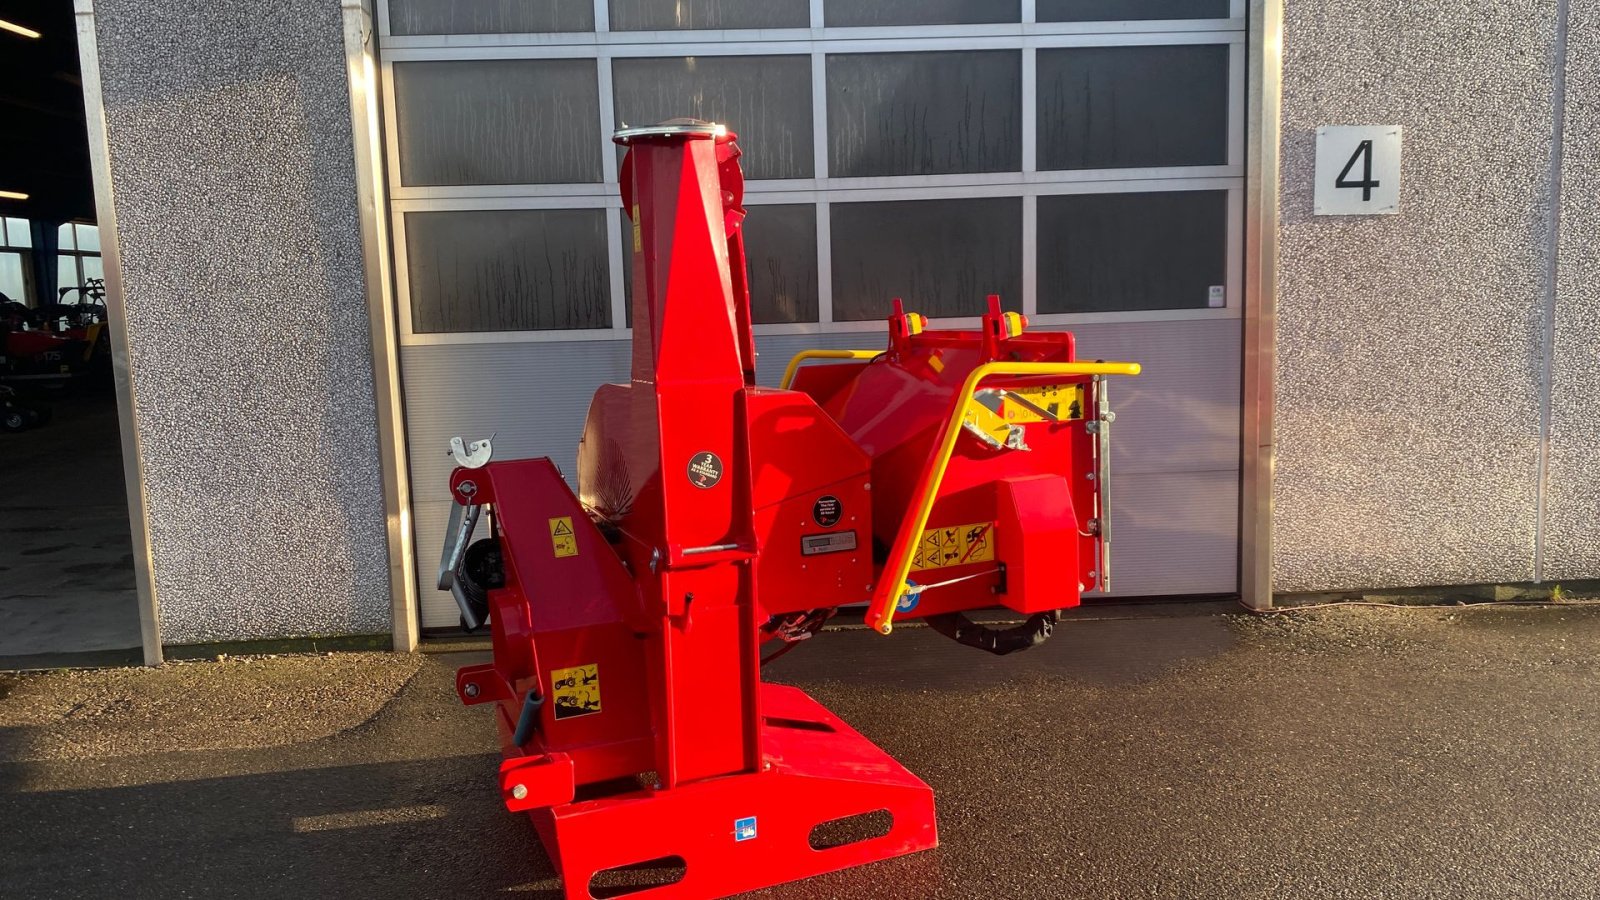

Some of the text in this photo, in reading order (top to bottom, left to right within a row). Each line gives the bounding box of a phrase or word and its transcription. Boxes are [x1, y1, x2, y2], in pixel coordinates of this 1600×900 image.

[1335, 140, 1380, 202] 4
[705, 454, 713, 463] 3
[692, 463, 718, 475] WARRANTY
